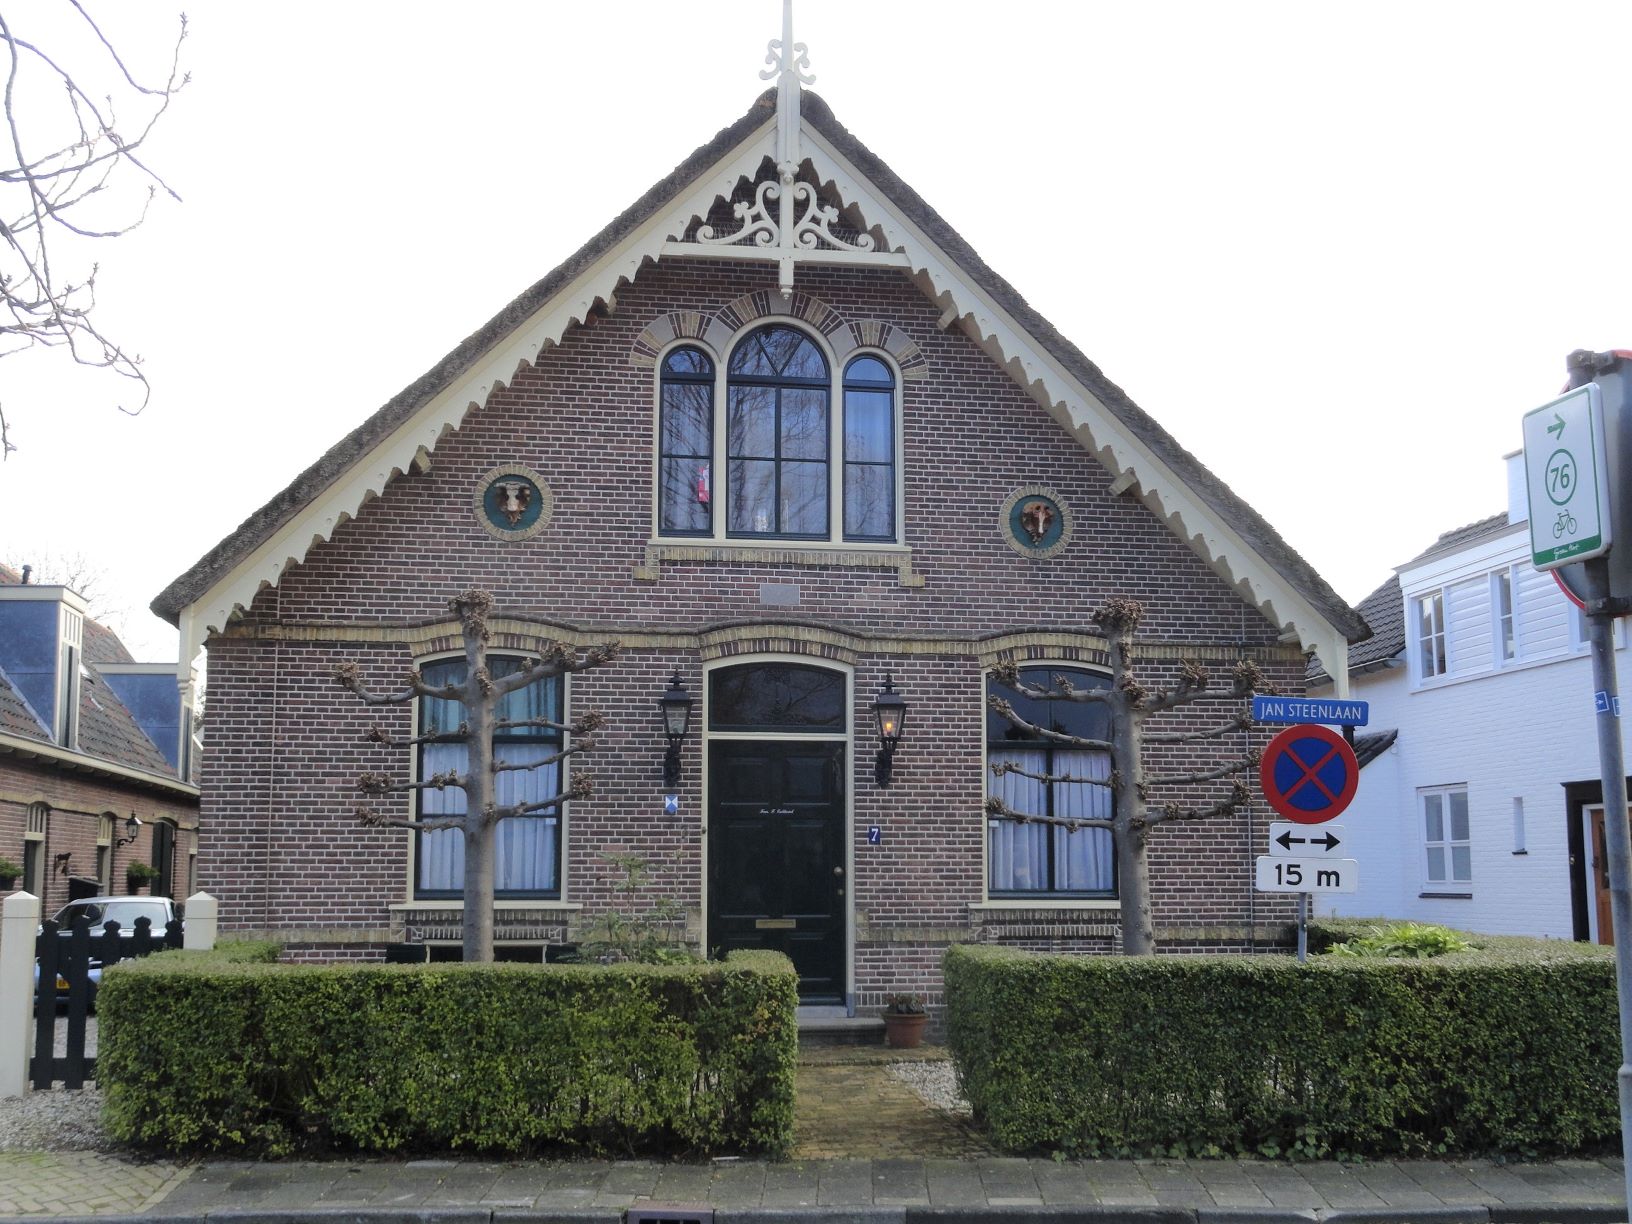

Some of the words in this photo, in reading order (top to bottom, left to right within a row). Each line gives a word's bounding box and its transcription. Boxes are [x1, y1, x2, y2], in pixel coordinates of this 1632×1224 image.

[1550, 463, 1570, 493] 76
[1260, 702, 1284, 720] JAN
[1288, 703, 1362, 720] STEENLAAN
[871, 827, 879, 842] 7
[1274, 863, 1303, 886] 15
[1316, 869, 1340, 887] m
